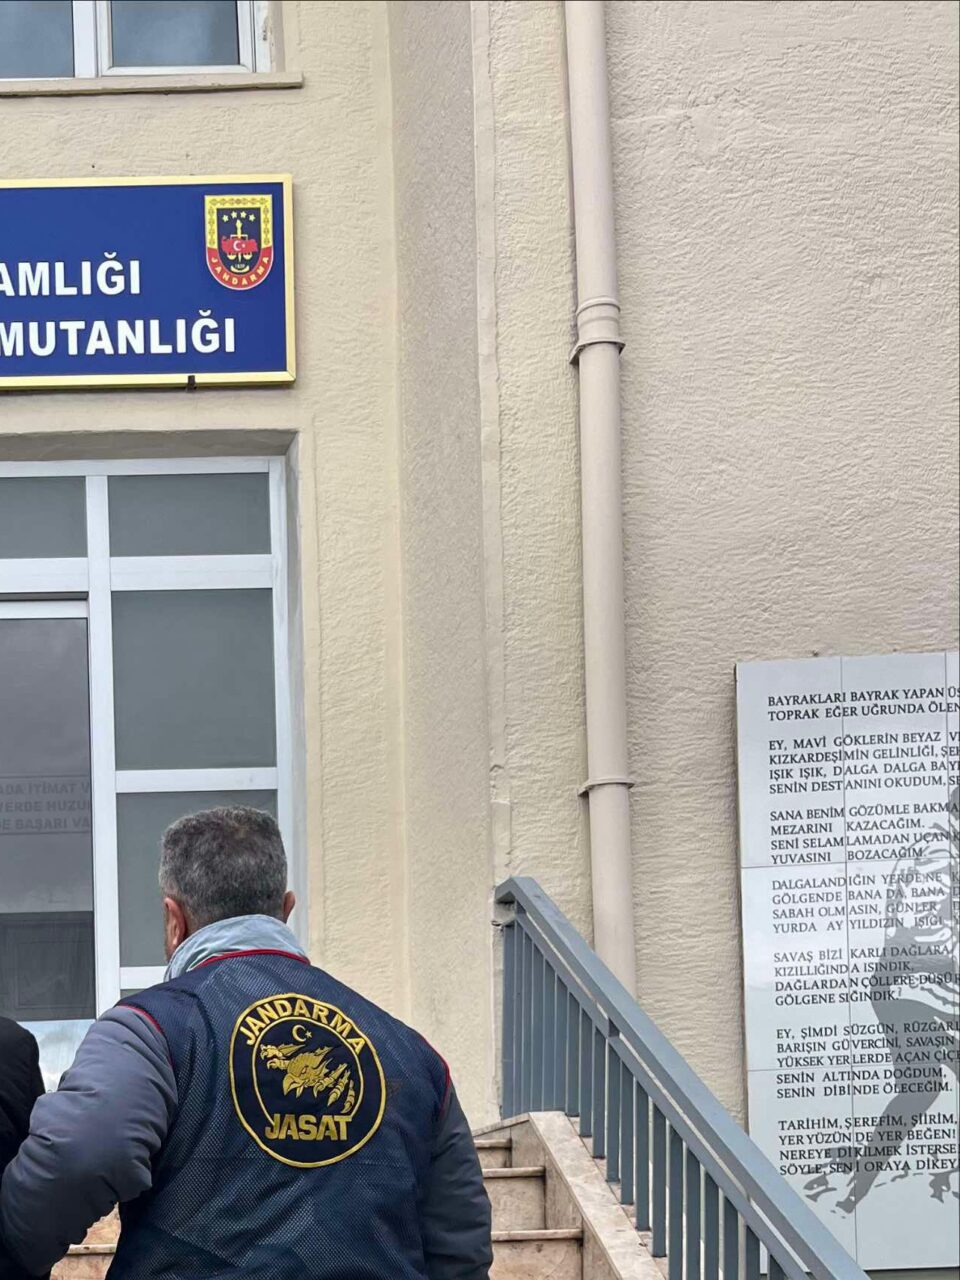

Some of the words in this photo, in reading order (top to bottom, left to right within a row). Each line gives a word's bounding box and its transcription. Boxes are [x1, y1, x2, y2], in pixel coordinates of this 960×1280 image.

[212, 257, 270, 285] JANDARMA
[768, 692, 846, 706] BAYRAKLARI
[851, 690, 899, 702] BAYRAK
[903, 688, 944, 699] YAPAN
[769, 709, 819, 721] TOPRAK
[826, 706, 857, 718] EĞER
[862, 703, 925, 716] UĞRUNDA
[769, 740, 787, 750] EY,
[794, 736, 826, 749] MAVİ
[834, 733, 898, 747] GÖKLERİN
[903, 732, 941, 743] BEYAZ
[769, 749, 868, 765] KIZKARDEŞİMİN
[873, 745, 938, 759] GELİNLİĞİ,
[770, 769, 793, 782] IŞIK
[800, 767, 827, 780] IŞIK,
[833, 764, 878, 776] DALGA
[884, 762, 926, 773] DALGA
[770, 781, 807, 794] SENİN
[812, 778, 881, 792] DESTANINI
[885, 776, 946, 788] OKUDUM,
[770, 810, 803, 821] SANA
[807, 806, 845, 819] BENİM
[849, 804, 910, 817] GÖZÜMLE
[771, 823, 832, 836] MEZARINI
[847, 818, 925, 832] KAZACAĞIM.
[771, 838, 799, 850] SENİ
[803, 833, 910, 848] SELAMLAMADAN
[914, 832, 949, 845] UÇAN
[772, 852, 831, 865] YUVASINI
[848, 848, 926, 861] BOZACAĞIM.
[772, 874, 876, 890] DALGALANDIĞIN
[772, 892, 843, 905] GÖLGENDE
[849, 890, 882, 900] BANA
[912, 886, 945, 898] BANA
[773, 908, 814, 920] SABAH
[819, 904, 881, 917] OLMASIN,
[887, 901, 937, 914] GÜNLER
[773, 922, 817, 934] YURDA
[827, 921, 843, 931] AY
[850, 918, 904, 930] YILDIZIN
[774, 951, 813, 964] SAVAŞ
[819, 948, 842, 960] BİZİ
[851, 948, 886, 959] KARLI
[891, 945, 949, 957] DAĞLARA
[775, 963, 860, 977] KIZILLIĞINDA
[775, 977, 859, 992] DAĞLARDAN
[862, 973, 915, 988] ÇÖLLERE
[775, 994, 836, 1006] GÖLGENE
[240, 1000, 367, 1055] JANDARMA
[777, 1029, 795, 1039] EY,
[801, 1025, 837, 1038] ŞİMDİ
[844, 1022, 898, 1035] SÜZGÜN,
[777, 1042, 828, 1053] BARIŞIN
[832, 1036, 902, 1050] GÜVERCİNİ,
[907, 1036, 955, 1047] SAVAŞIN
[777, 1056, 824, 1068] YÜKSEK
[828, 1052, 891, 1065] YERLERDE
[896, 1051, 930, 1064] AÇAN
[777, 1072, 815, 1084] SENİN
[823, 1070, 880, 1082] ALTINDA
[884, 1067, 947, 1079] DOĞDUM,
[777, 1086, 815, 1099] SENİN
[824, 1084, 880, 1097] DİBİNDE
[883, 1082, 952, 1093] ÖLECEĞİM.
[265, 1113, 353, 1141] JASAT
[778, 1117, 843, 1130] TARİHİM,
[845, 1115, 907, 1129] ŞEREFİM,
[912, 1112, 957, 1125] ŞİİRİM,
[878, 1131, 903, 1141] YER
[908, 1129, 956, 1140] BEĞEN!
[780, 1148, 832, 1161] NEREYE
[838, 1145, 902, 1158] DİKİLMEK
[830, 1162, 860, 1173] SENİ
[865, 1161, 911, 1172] ORAYA
